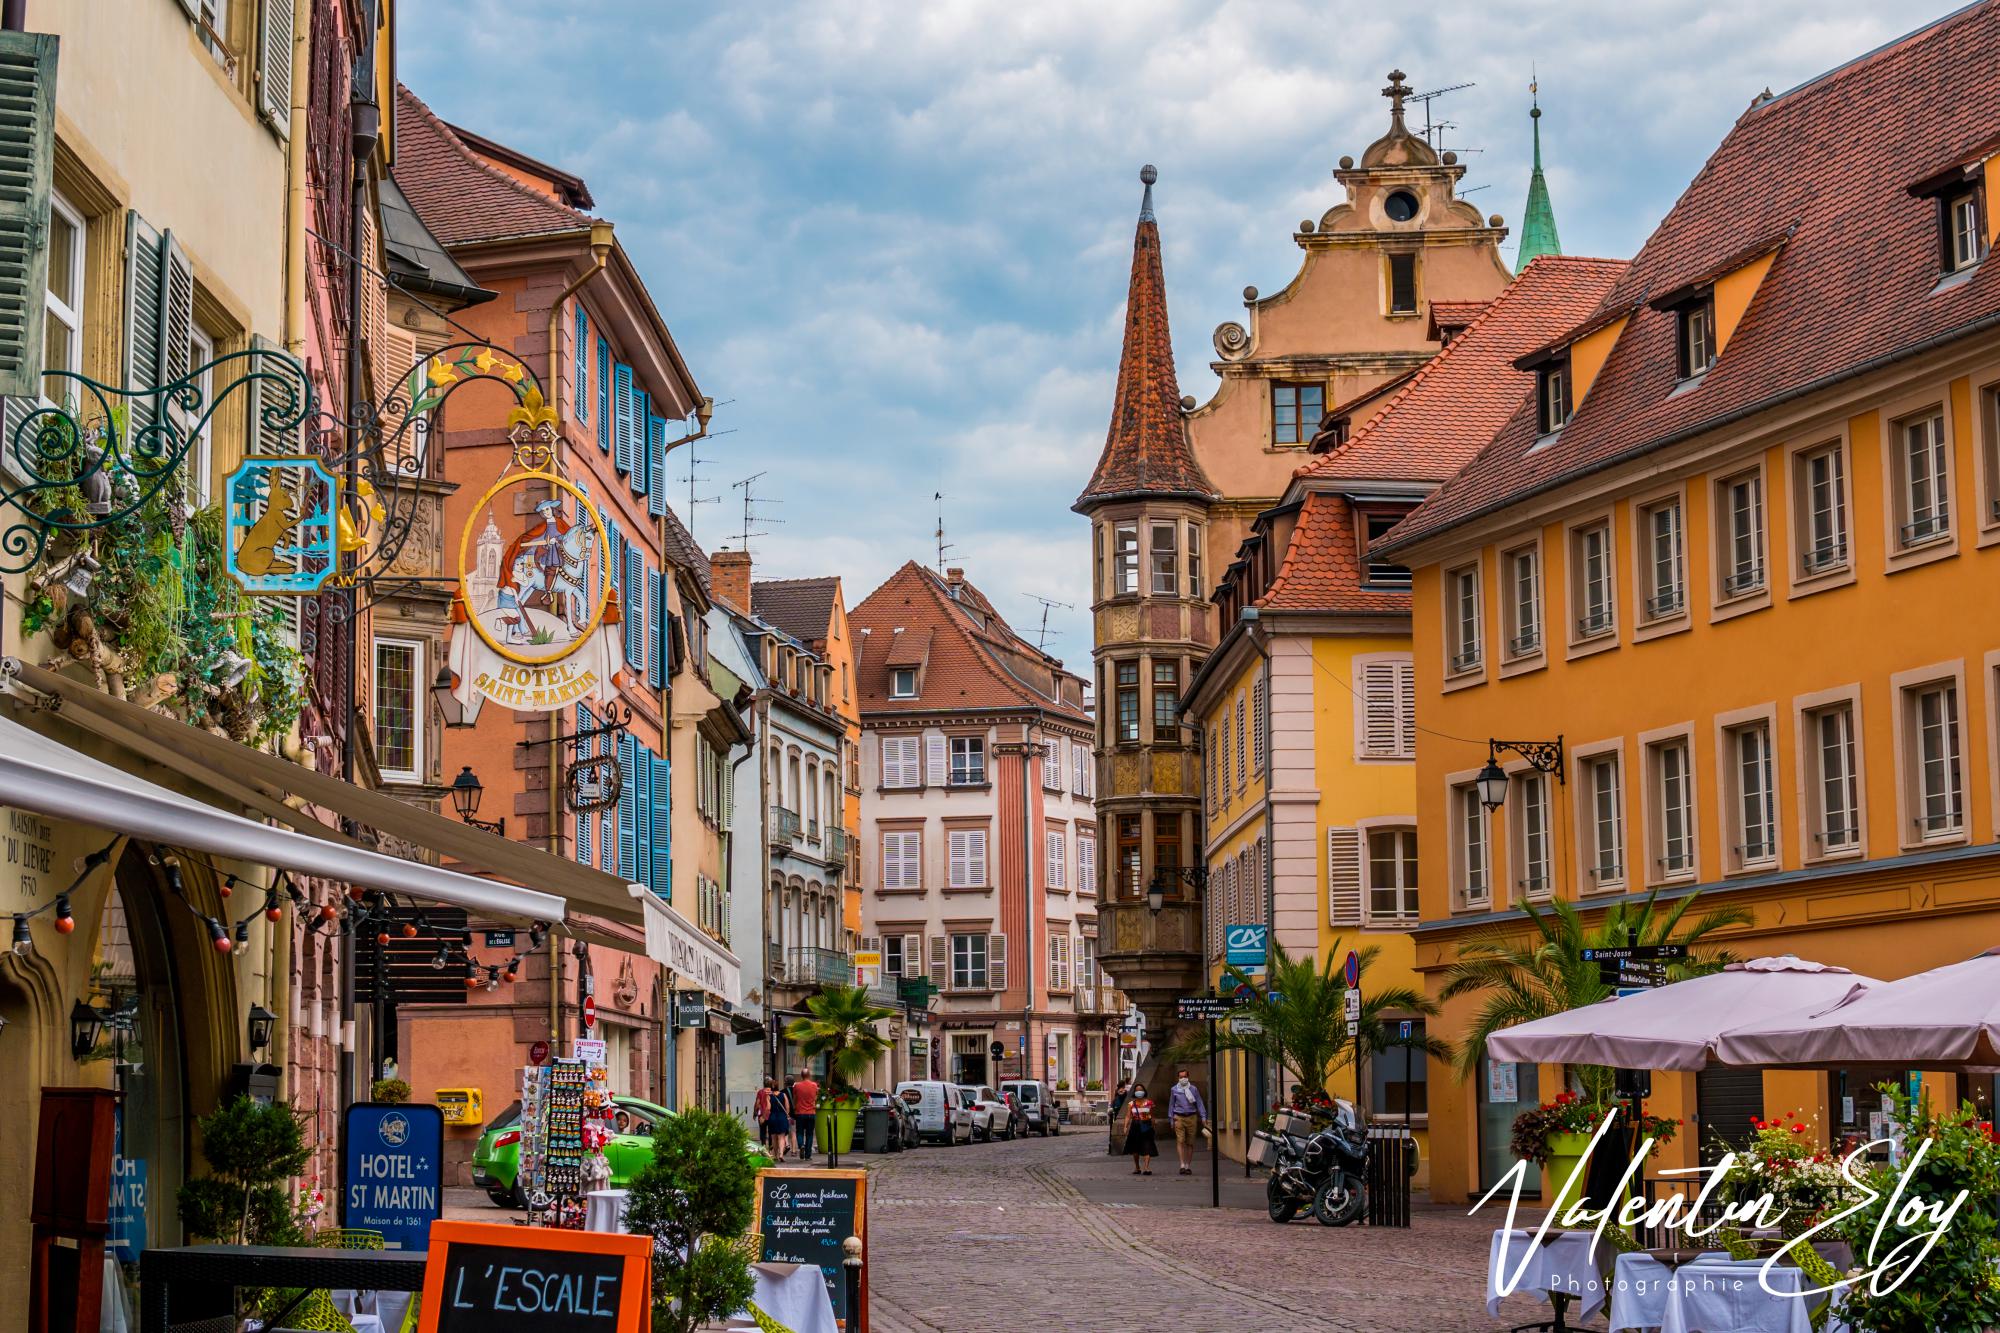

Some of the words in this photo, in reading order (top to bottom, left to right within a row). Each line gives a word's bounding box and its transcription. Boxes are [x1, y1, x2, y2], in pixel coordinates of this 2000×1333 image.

[499, 664, 574, 687] HOTEL
[473, 670, 600, 706] SAINT-MARTIN
[10, 810, 37, 839] MAISON
[360, 1154, 415, 1179] HOTEL
[351, 1184, 367, 1208] ST
[374, 1185, 435, 1210] MARTIN
[770, 1184, 791, 1200] Les
[782, 1200, 789, 1208] la
[363, 1216, 391, 1225] Maison
[393, 1216, 403, 1225] de
[406, 1217, 421, 1226] 1361
[766, 1215, 790, 1226] Salade
[828, 1217, 837, 1226] et
[802, 1226, 810, 1234] de
[766, 1249, 788, 1262] Salade
[453, 1264, 617, 1317] L'ESCALE
